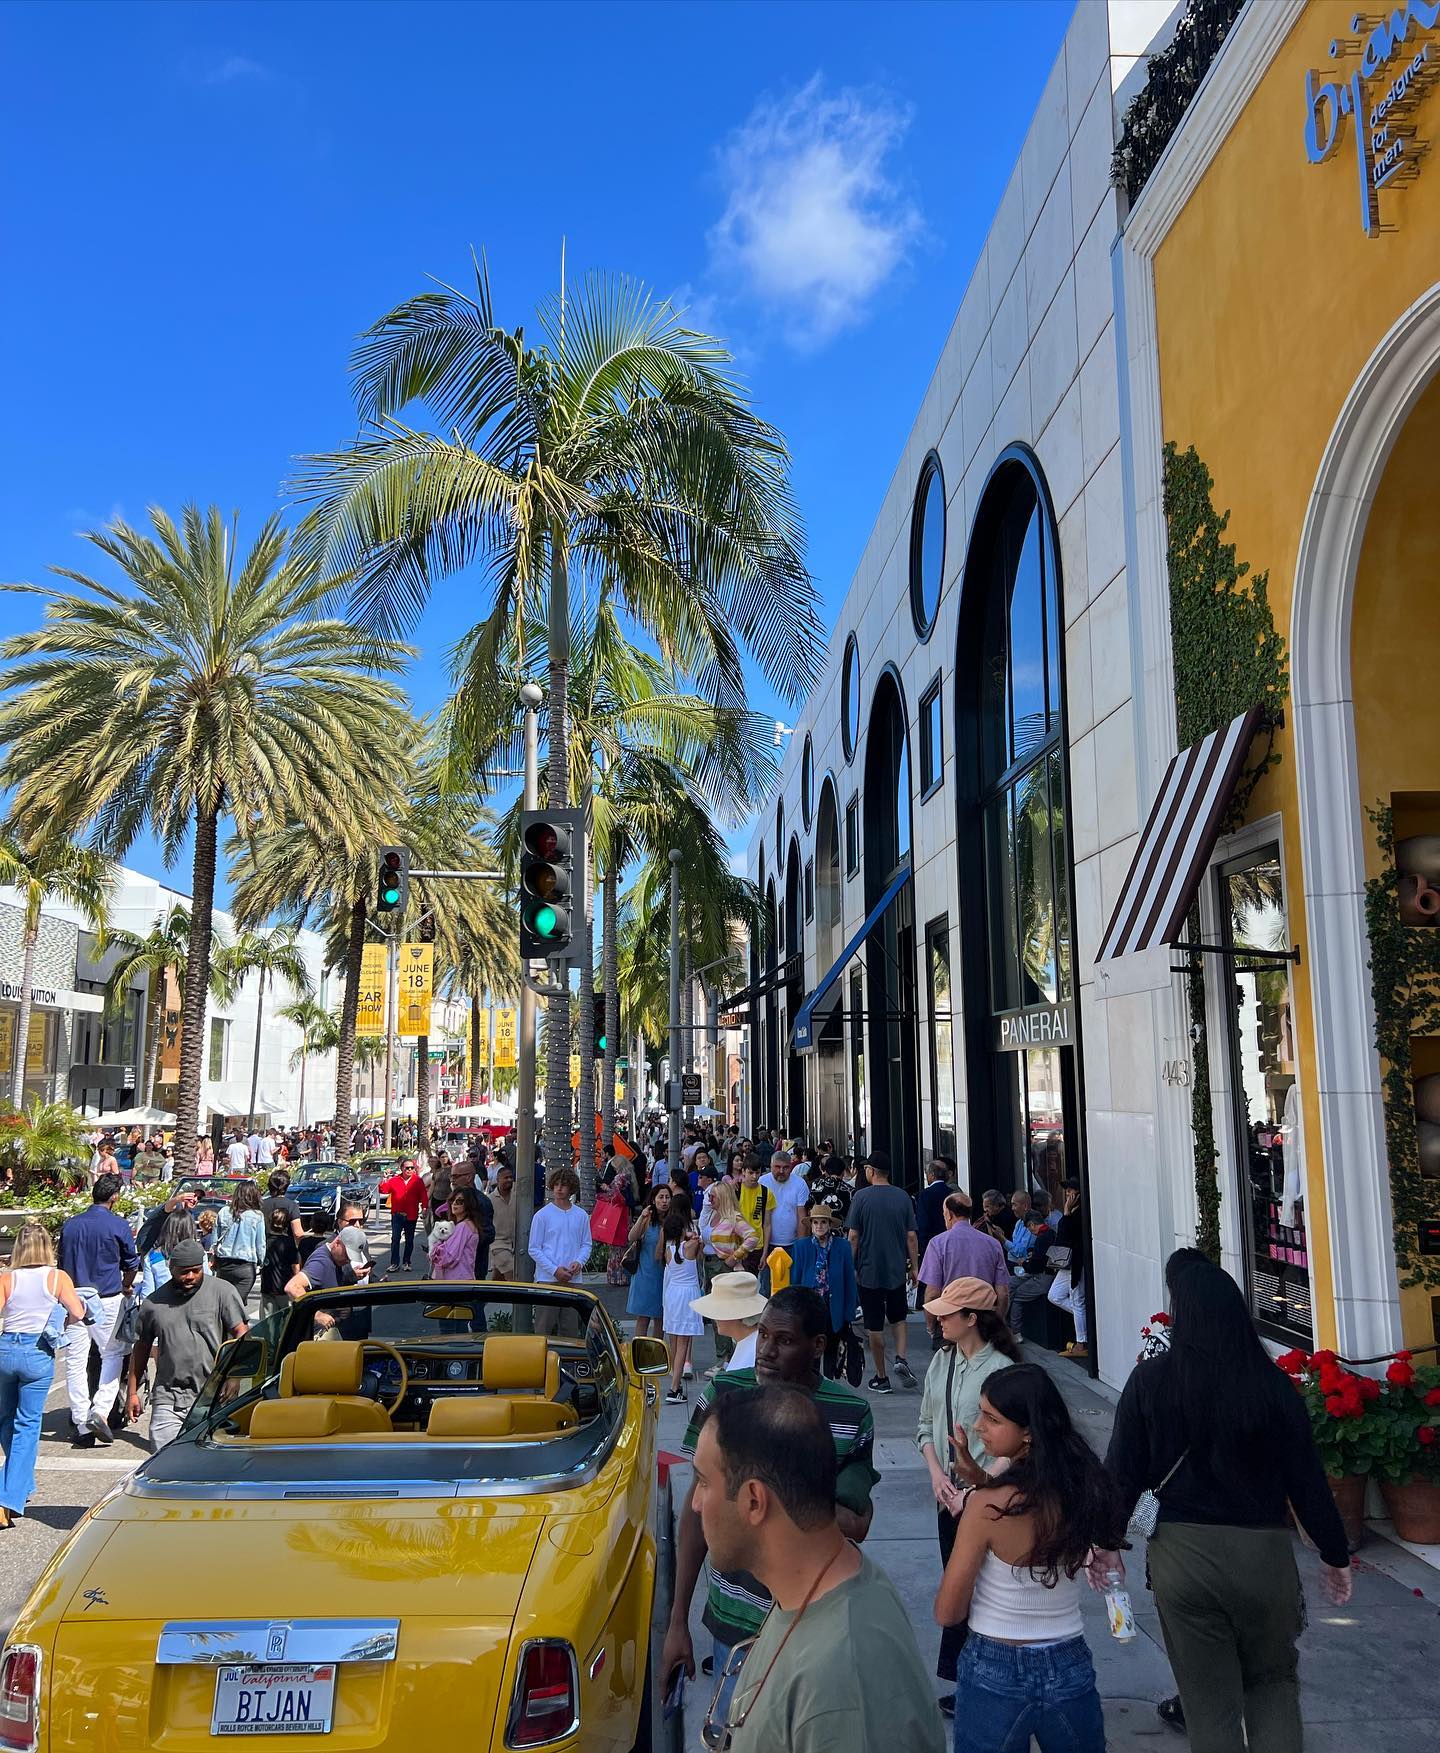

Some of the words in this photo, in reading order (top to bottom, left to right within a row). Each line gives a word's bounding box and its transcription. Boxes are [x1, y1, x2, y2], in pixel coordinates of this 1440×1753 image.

[1369, 43, 1428, 129] designer
[1371, 122, 1389, 155] for
[1372, 138, 1403, 183] men
[403, 964, 429, 972] JUNE
[31, 988, 56, 1004] UITTON
[357, 991, 382, 1002] CAR
[356, 1004, 382, 1012] SHOW
[1001, 1008, 1068, 1046] PANERAI
[1162, 1060, 1190, 1087] 443
[224, 1672, 238, 1682] JUL
[242, 1672, 310, 1689] California
[235, 1690, 312, 1723] BIJAN
[220, 1724, 236, 1732] ROLLS
[237, 1724, 254, 1732] ROYCE
[285, 1723, 307, 1731] BEVERLY
[307, 1722, 322, 1731] HILLS
